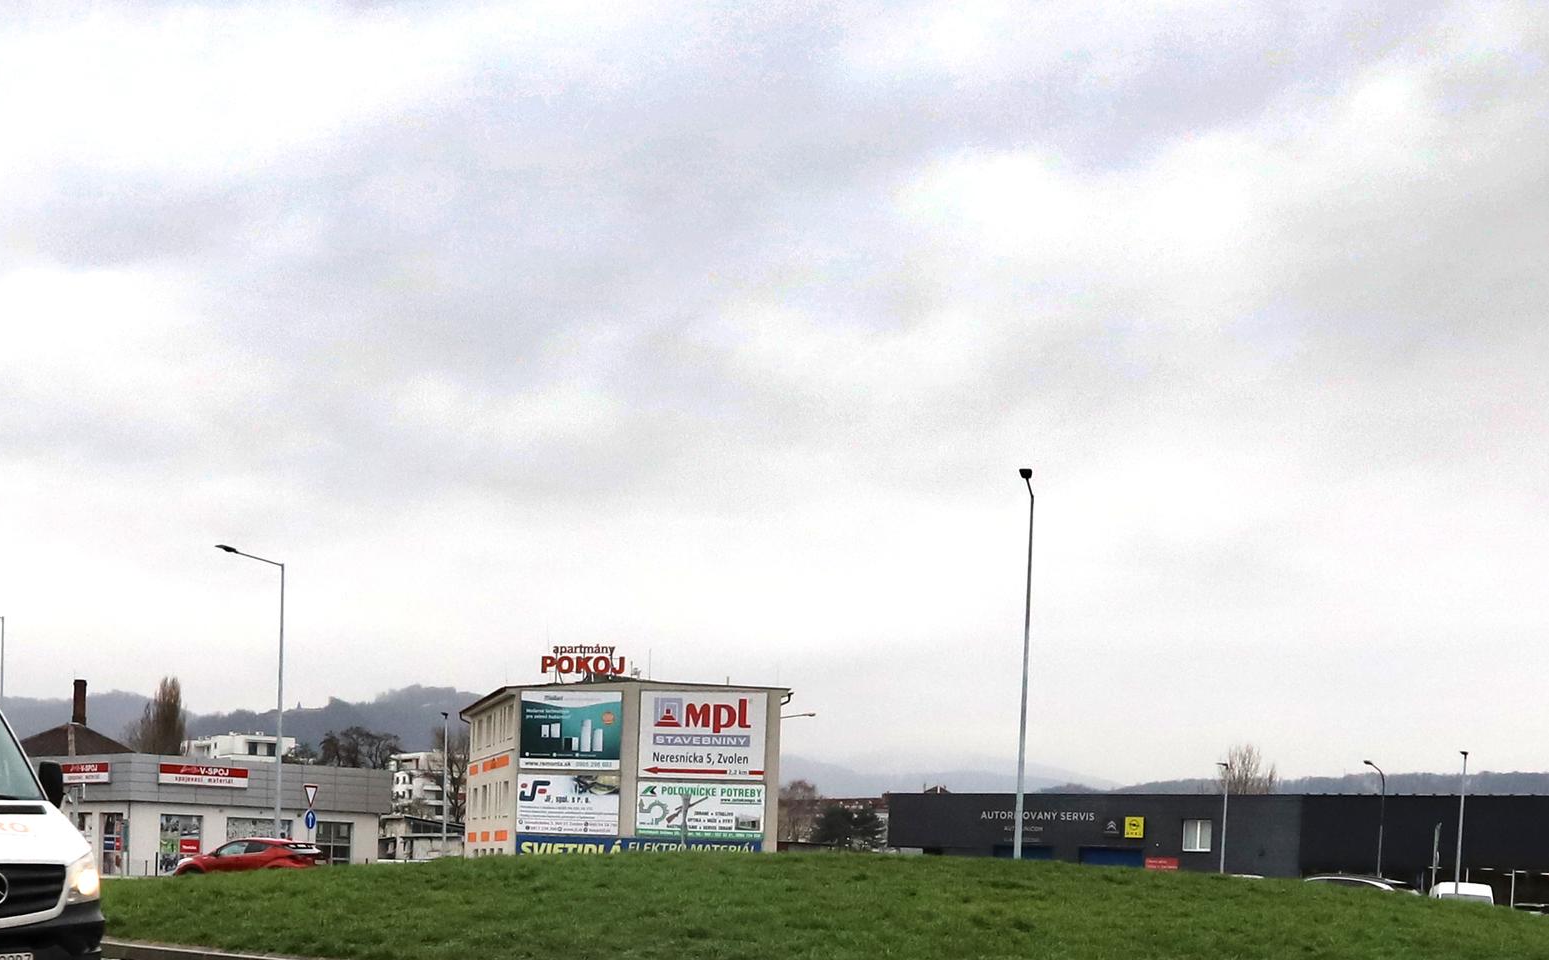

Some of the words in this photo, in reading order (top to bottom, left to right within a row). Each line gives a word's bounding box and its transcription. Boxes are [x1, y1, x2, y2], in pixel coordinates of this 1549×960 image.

[553, 644, 615, 656] apartmány
[541, 656, 625, 674] POKOJ
[655, 735, 748, 746] STAVEBNINY
[717, 753, 749, 765] Zvolen
[199, 766, 230, 777] V-SPOJ
[720, 787, 762, 798] POTREBY
[1060, 811, 1096, 821] SERVIS
